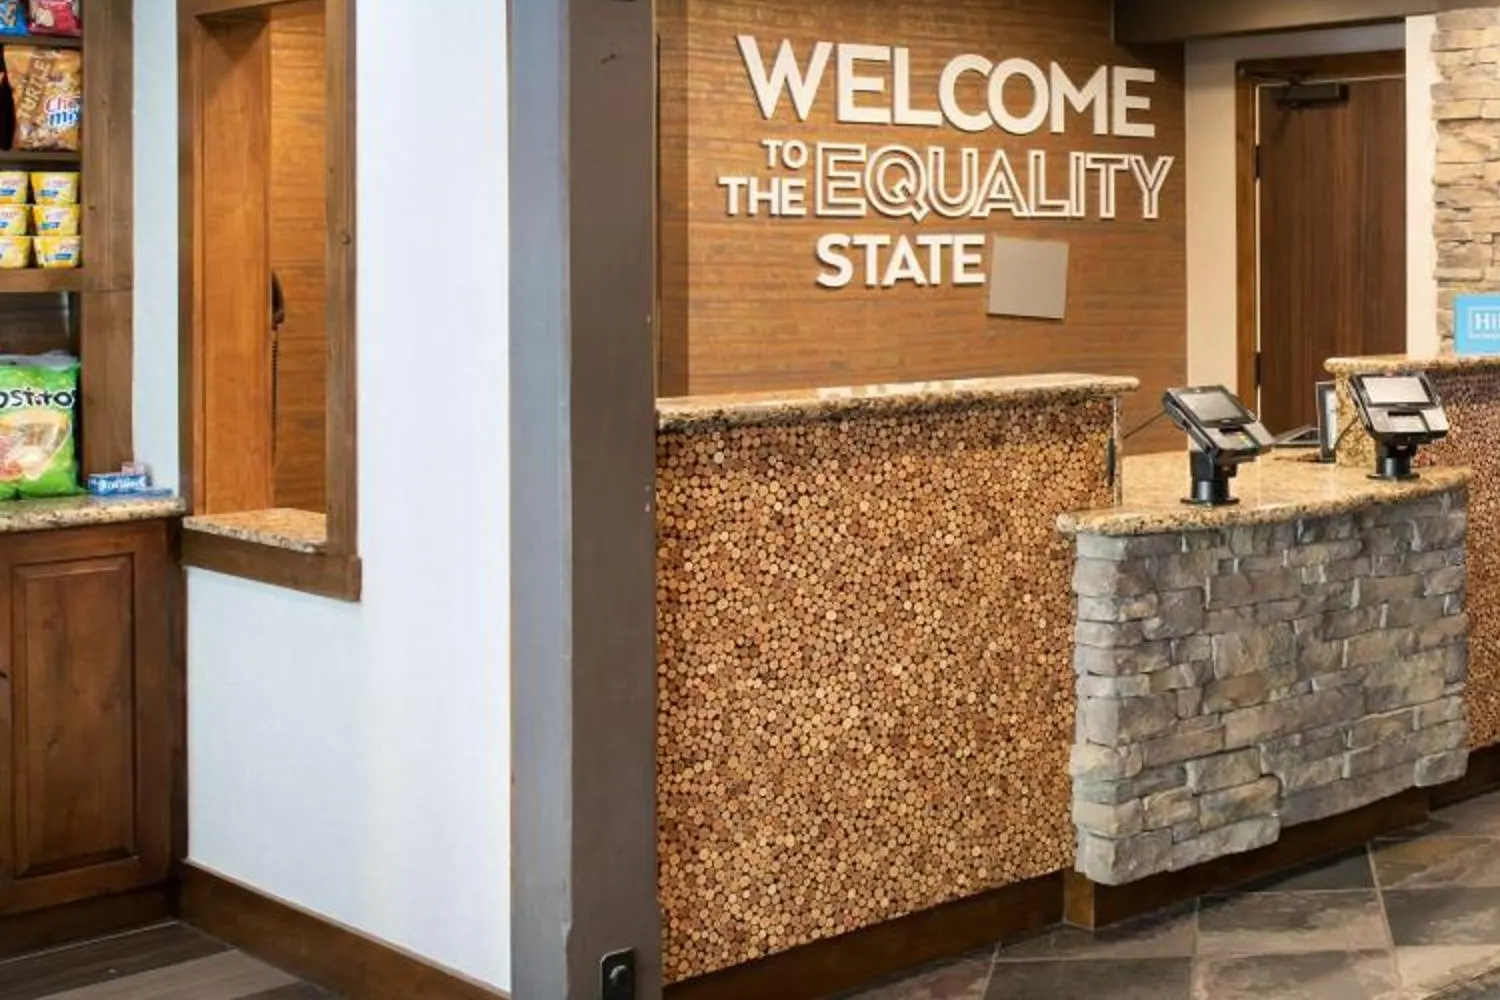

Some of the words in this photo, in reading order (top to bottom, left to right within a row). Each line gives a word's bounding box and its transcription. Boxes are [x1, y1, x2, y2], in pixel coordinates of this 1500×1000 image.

[736, 34, 1156, 138] WELCOME
[718, 175, 807, 216] THE
[814, 142, 1174, 222] EQUALITY
[762, 138, 808, 170] TO
[815, 233, 985, 288] STATE
